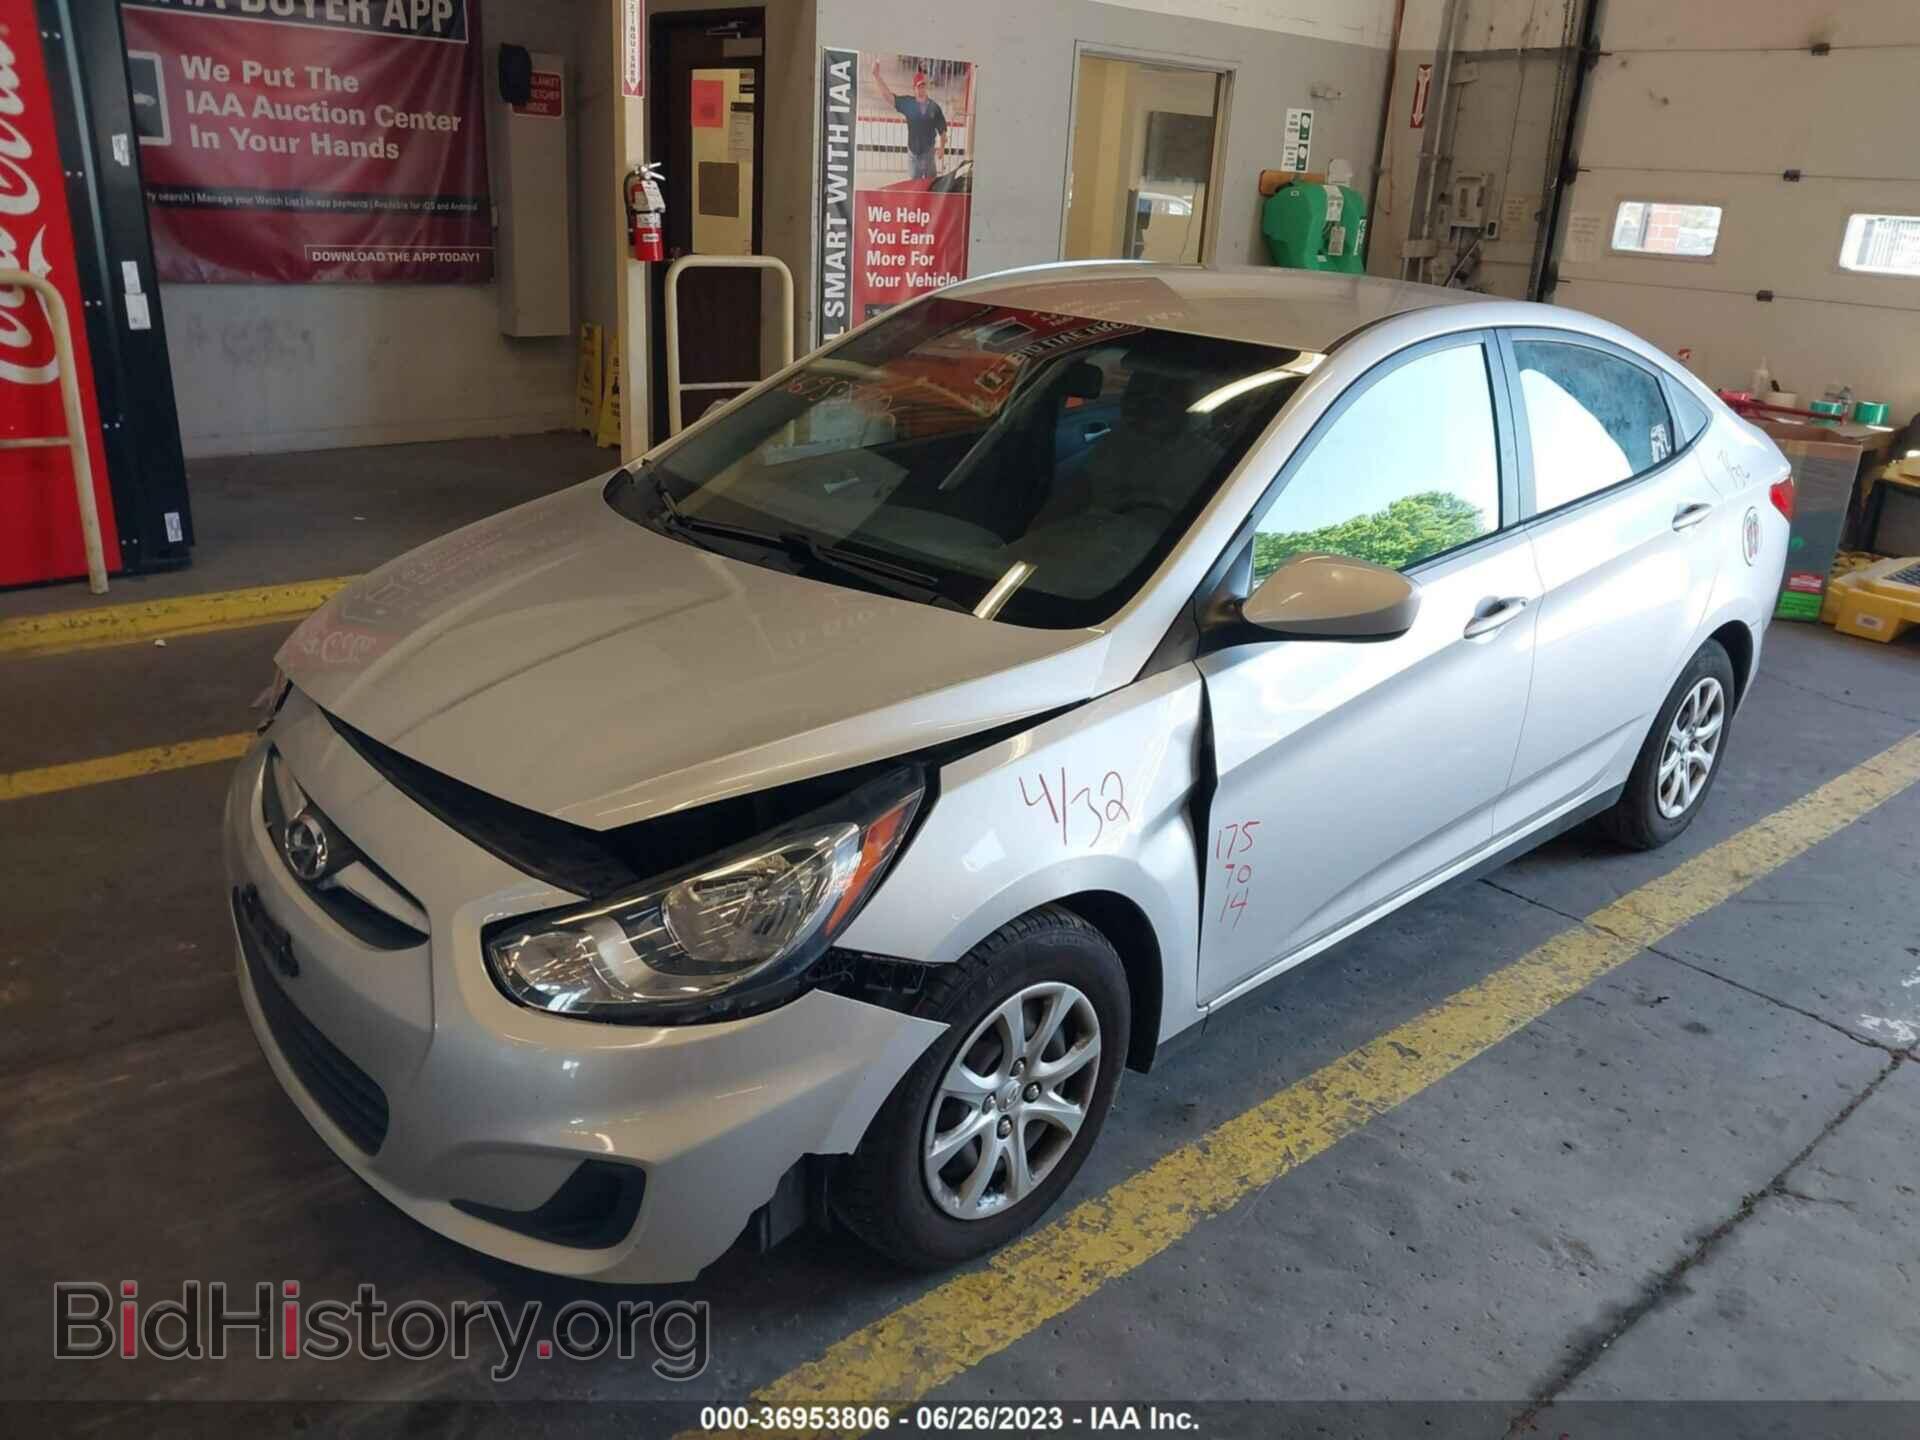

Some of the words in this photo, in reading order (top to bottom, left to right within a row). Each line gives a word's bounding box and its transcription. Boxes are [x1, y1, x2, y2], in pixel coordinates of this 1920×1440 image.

[381, 0, 453, 32] APP
[180, 55, 230, 82] We
[241, 60, 295, 88] Put
[304, 66, 359, 93] The
[829, 60, 852, 113] IAA
[185, 90, 244, 118] IAA
[252, 95, 366, 126] Auction
[374, 105, 461, 132] Center
[190, 125, 220, 149] In
[229, 127, 300, 154] Your
[311, 132, 399, 160] Hands
[826, 123, 849, 201] WITH
[867, 206, 892, 223] We
[896, 207, 930, 227] Help
[867, 228, 896, 245] You
[901, 229, 935, 245] Earn
[312, 251, 385, 262] DOWNLOAD
[387, 252, 410, 262] THE
[412, 252, 437, 262] APP
[438, 252, 480, 263] TODAY!
[824, 213, 847, 318] SMART
[866, 250, 906, 267] More
[911, 250, 935, 267] For
[866, 271, 901, 288] Your
[1018, 766, 1131, 848] 4/32
[1216, 821, 1261, 859] 175
[1225, 864, 1252, 889] 70
[1219, 887, 1250, 930] 14
